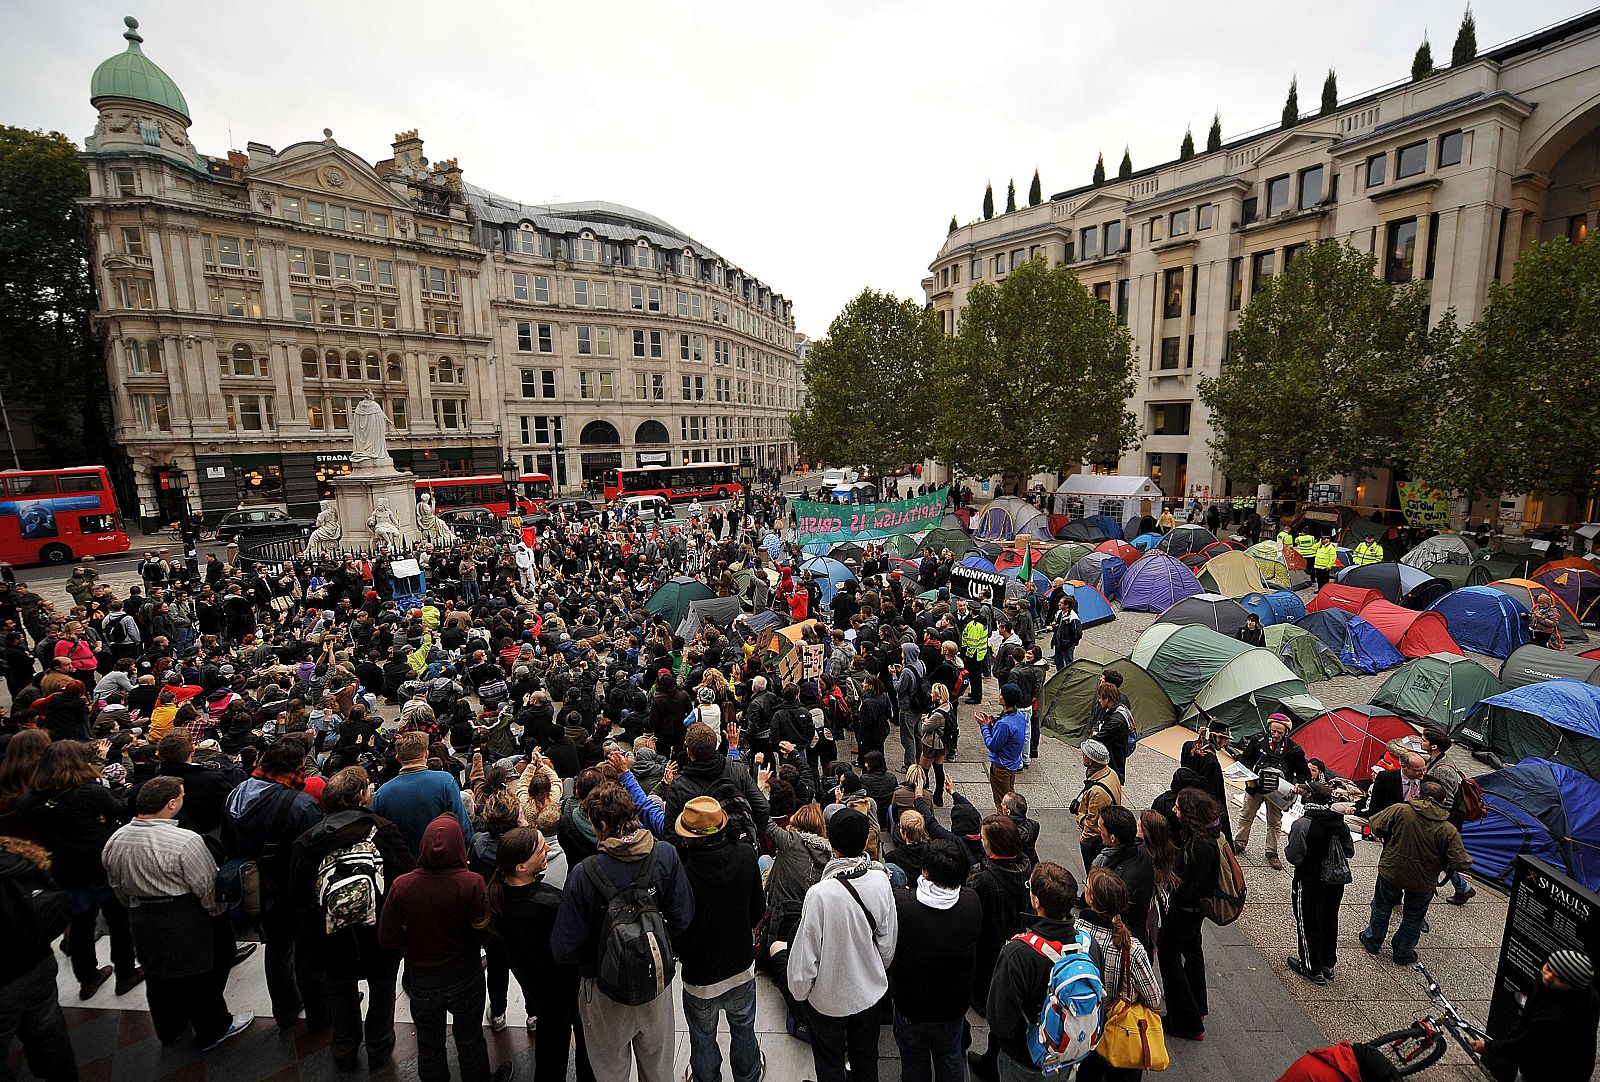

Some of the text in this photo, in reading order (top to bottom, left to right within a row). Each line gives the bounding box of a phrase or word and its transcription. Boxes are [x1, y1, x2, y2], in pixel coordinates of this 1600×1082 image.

[316, 454, 349, 462] STRADA
[951, 566, 1006, 586] ANONYMOUS
[1550, 883, 1590, 917] PAUL'S
